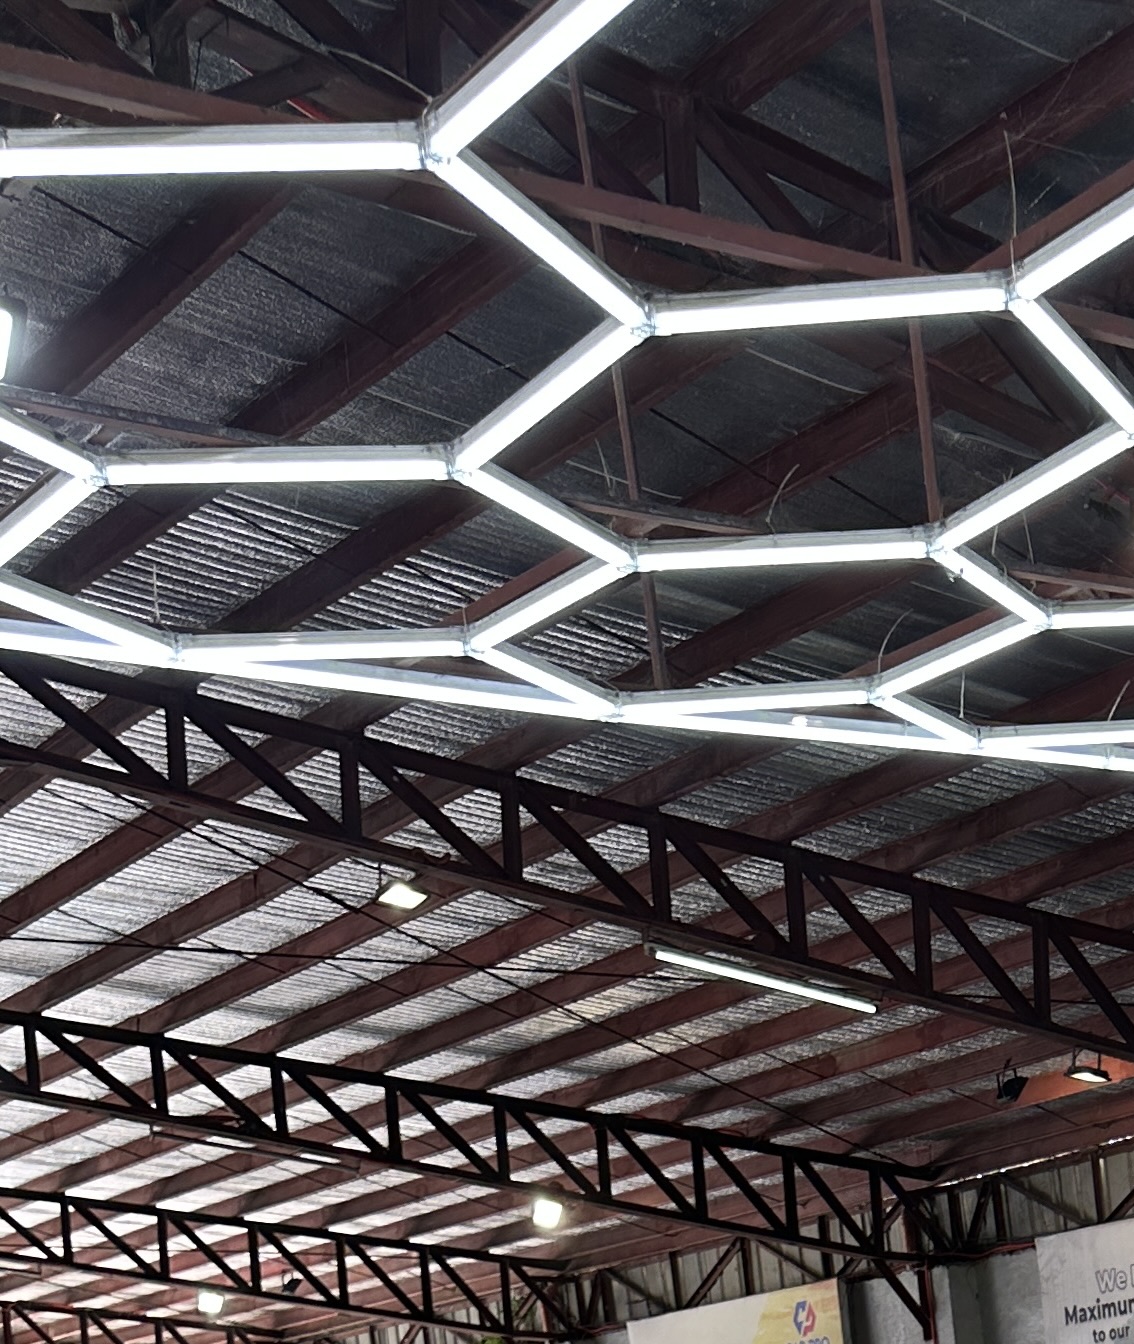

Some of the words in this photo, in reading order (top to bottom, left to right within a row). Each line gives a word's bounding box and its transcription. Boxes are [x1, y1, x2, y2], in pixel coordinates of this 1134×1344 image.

[1095, 1268, 1127, 1293] We
[1093, 1328, 1106, 1343] to
[1109, 1326, 1130, 1340] our
